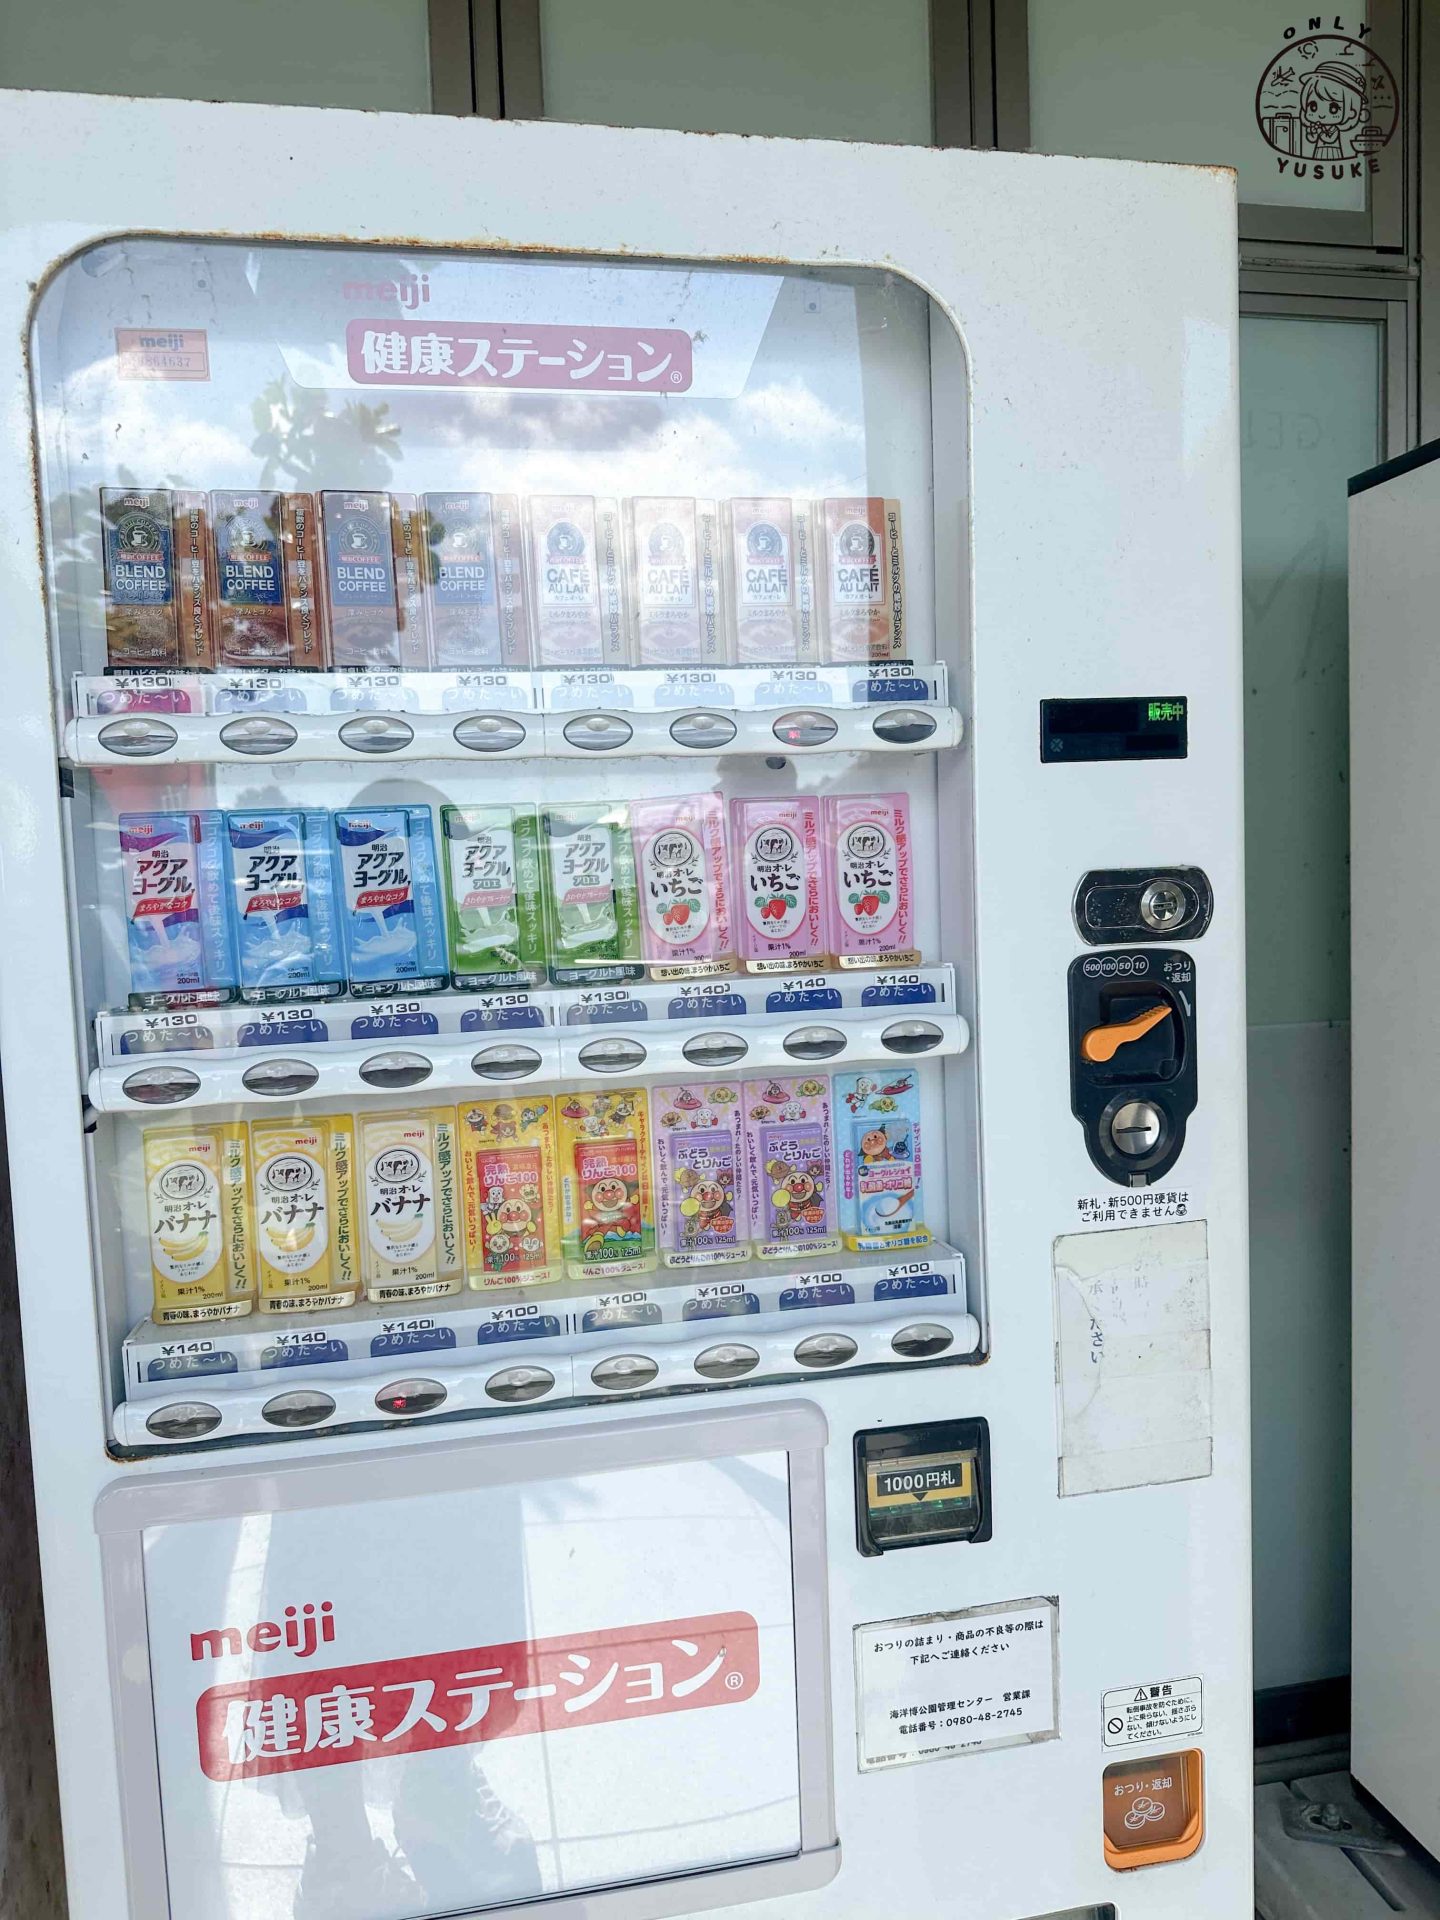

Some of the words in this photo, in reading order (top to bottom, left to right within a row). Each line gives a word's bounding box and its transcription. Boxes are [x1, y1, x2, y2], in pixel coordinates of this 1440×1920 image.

[343, 274, 430, 310] meiji
[139, 334, 184, 351] meiji
[116, 565, 165, 578] BLEND
[226, 566, 274, 578] BLEND
[337, 567, 385, 579] BLEND
[439, 567, 484, 578] BLEND
[547, 565, 590, 584] CAFÉ
[648, 566, 690, 584] CAFÉ
[746, 565, 787, 583] CAFÉ
[838, 565, 879, 582] CAFÉ
[116, 580, 167, 591] COFFEE
[227, 580, 275, 590] COFFEE
[338, 581, 387, 592] COFFEE
[440, 581, 485, 591] COFFEE
[549, 585, 563, 594] AU
[566, 585, 590, 594] LAIT
[649, 585, 663, 594] AU
[666, 585, 690, 594] LAIT
[748, 584, 761, 593] AU
[764, 584, 788, 592] LAIT
[839, 583, 853, 592] AU
[856, 583, 879, 591] LAIT
[350, 676, 399, 687] ¥130
[459, 676, 507, 686] ¥130
[773, 671, 816, 680] ¥130
[229, 678, 281, 688] ¥130
[1149, 703, 1183, 720] 販売中
[129, 825, 153, 833] meiji
[465, 845, 507, 861] アクア
[565, 843, 606, 858] アクア
[249, 855, 297, 872] アクア
[358, 852, 404, 869] アクア
[562, 858, 609, 874] ヨーグル
[137, 859, 188, 875] アクア
[462, 862, 510, 878] ヨーグル
[245, 873, 302, 891] ヨーグル
[353, 869, 408, 887] ヨーグル
[473, 879, 501, 889] アロエ
[573, 875, 600, 885] アロエ
[750, 873, 800, 892] いちご
[843, 870, 893, 888] いちご
[133, 876, 192, 895] ヨーグル
[650, 877, 703, 898] いちご
[361, 893, 405, 905] まろやかなコク
[139, 900, 188, 913] まろやかなコク
[1085, 962, 1100, 971] 500
[1102, 962, 1116, 970] 100
[1119, 961, 1130, 970] 50
[1135, 960, 1145, 969] 10
[1164, 961, 1191, 971] おつり
[783, 978, 826, 990] ¥140
[877, 975, 918, 984] ¥140
[145, 992, 220, 1005] ヨーグルト風味
[481, 994, 528, 1007] ¥130
[371, 1003, 420, 1014] ¥130
[262, 1009, 312, 1021] ¥130
[145, 1015, 198, 1028] ¥130
[769, 1141, 798, 1151] ぶどう
[678, 1148, 708, 1159] ぶどう
[783, 1148, 821, 1160] とりんご
[584, 1159, 608, 1169] 完熟
[693, 1156, 732, 1169] とりんご
[485, 1165, 508, 1175] 完熟
[583, 1165, 636, 1180] りんご100
[484, 1173, 537, 1185] りんご100
[371, 1194, 430, 1215] バナナ
[1078, 1192, 1189, 1210] 新札・新500円硬貨は
[261, 1202, 324, 1224] バナナ
[1081, 1206, 1175, 1221] ご利用できません
[154, 1210, 217, 1234] バナナ
[807, 1226, 826, 1234] 125ml
[715, 1236, 735, 1244] 125ml
[621, 1248, 641, 1257] 125ml
[392, 1267, 418, 1275] 果汁1%
[888, 1263, 929, 1275] ¥100
[284, 1278, 310, 1286] 果汁1%
[800, 1274, 842, 1284] ¥100
[177, 1287, 205, 1295] 果汁1%
[308, 1283, 327, 1291] 200ml
[379, 1284, 450, 1298] 青春の味、まろやかバナナ
[492, 1306, 538, 1320] ¥100
[276, 1332, 325, 1346] ¥140
[162, 1342, 213, 1356] ¥140
[884, 1471, 955, 1493] 1000円札
[190, 1601, 335, 1661] meiji
[910, 1641, 1010, 1665] 下記へご連絡ください
[1150, 1685, 1172, 1697] 警告
[890, 1696, 993, 1719] 海洋博公園管理センター
[1003, 1689, 1031, 1702] 営業課
[1127, 1730, 1163, 1740] てください。
